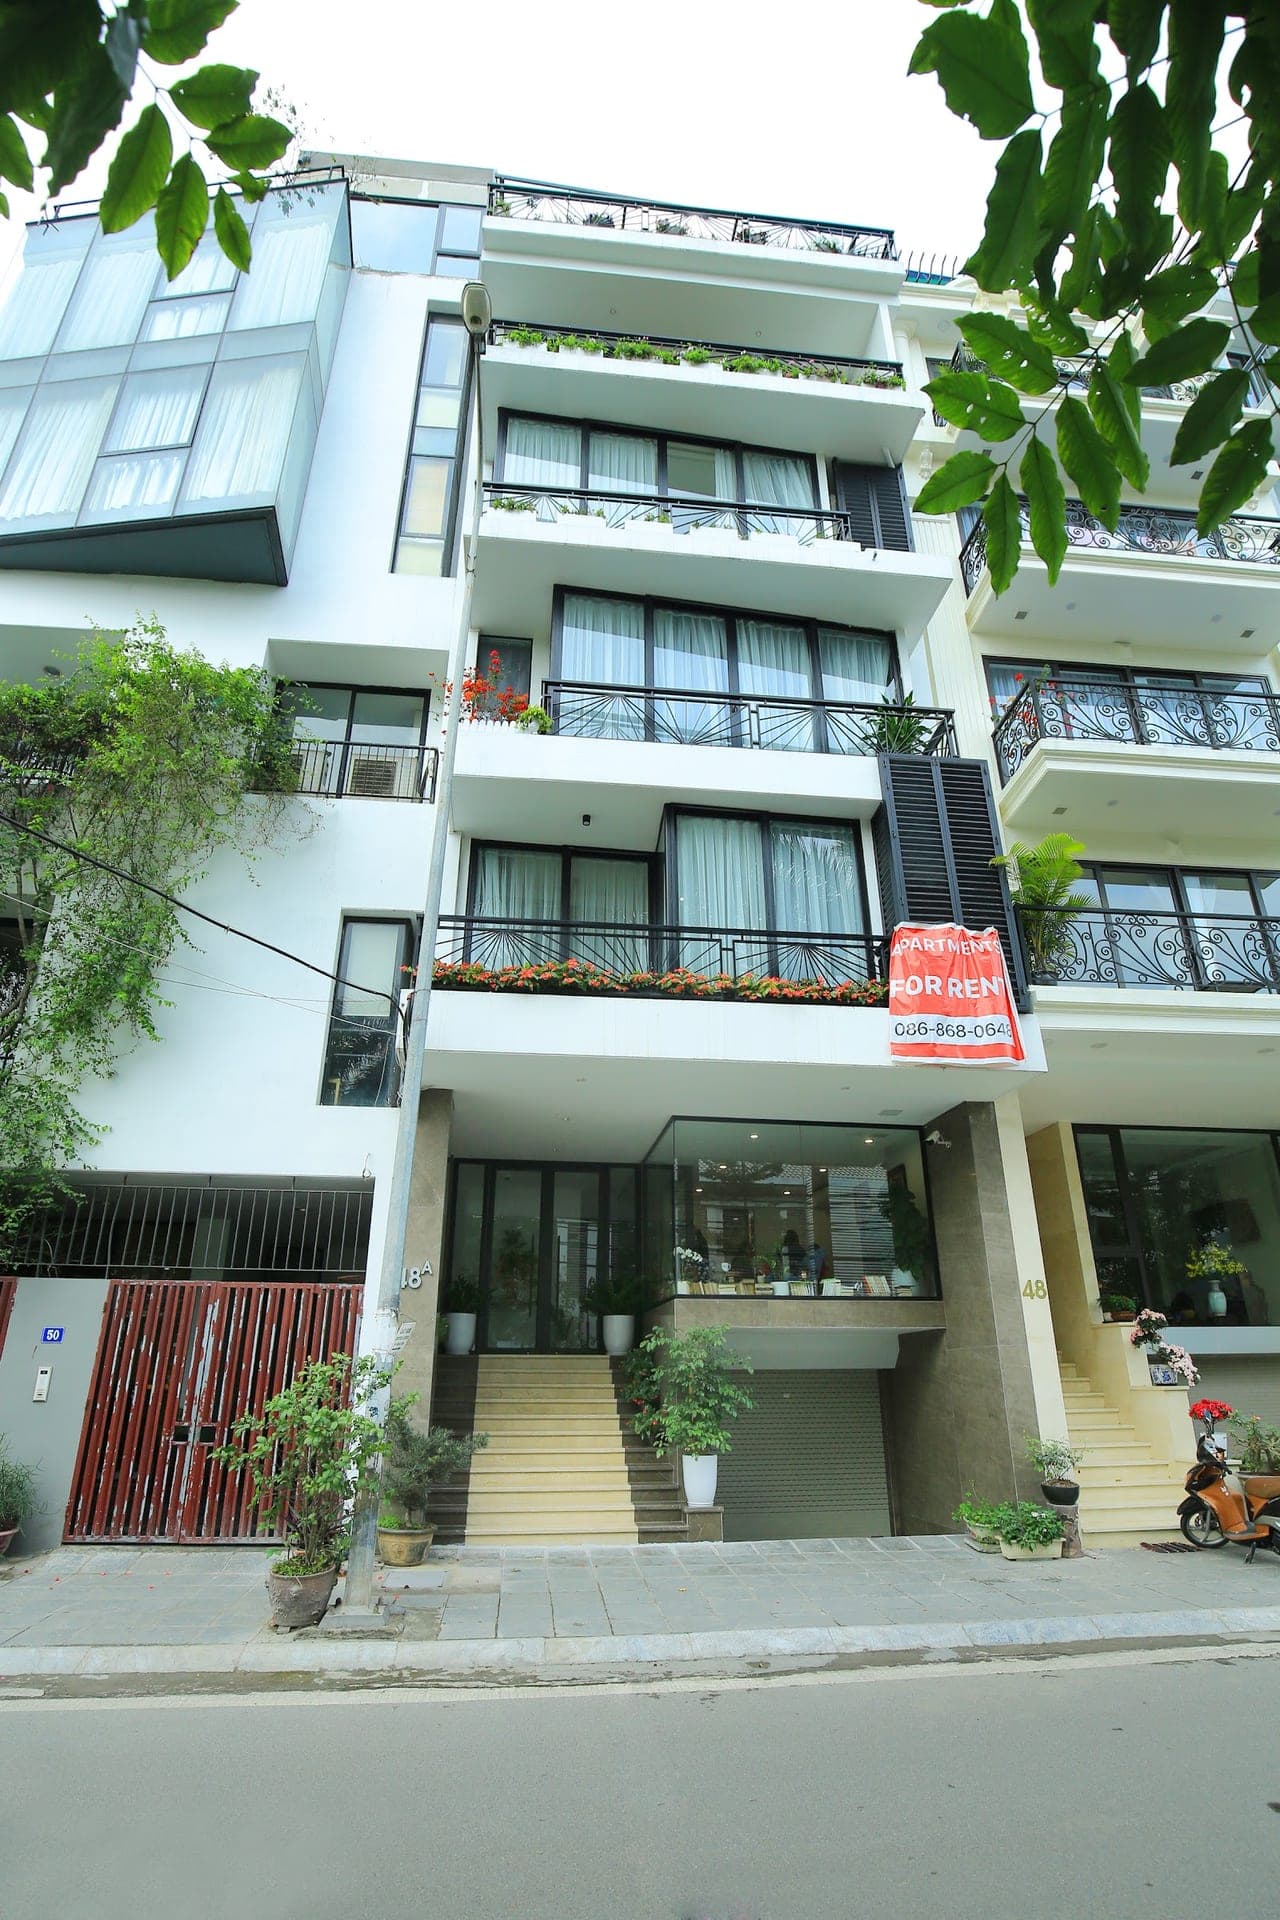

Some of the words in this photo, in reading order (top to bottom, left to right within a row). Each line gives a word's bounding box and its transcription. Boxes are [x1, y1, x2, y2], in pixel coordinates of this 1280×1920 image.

[891, 937, 1000, 956] APARTMENTS
[890, 976, 942, 997] FOR
[1023, 1280, 1047, 1299] 48
[46, 1330, 60, 1341] 50
